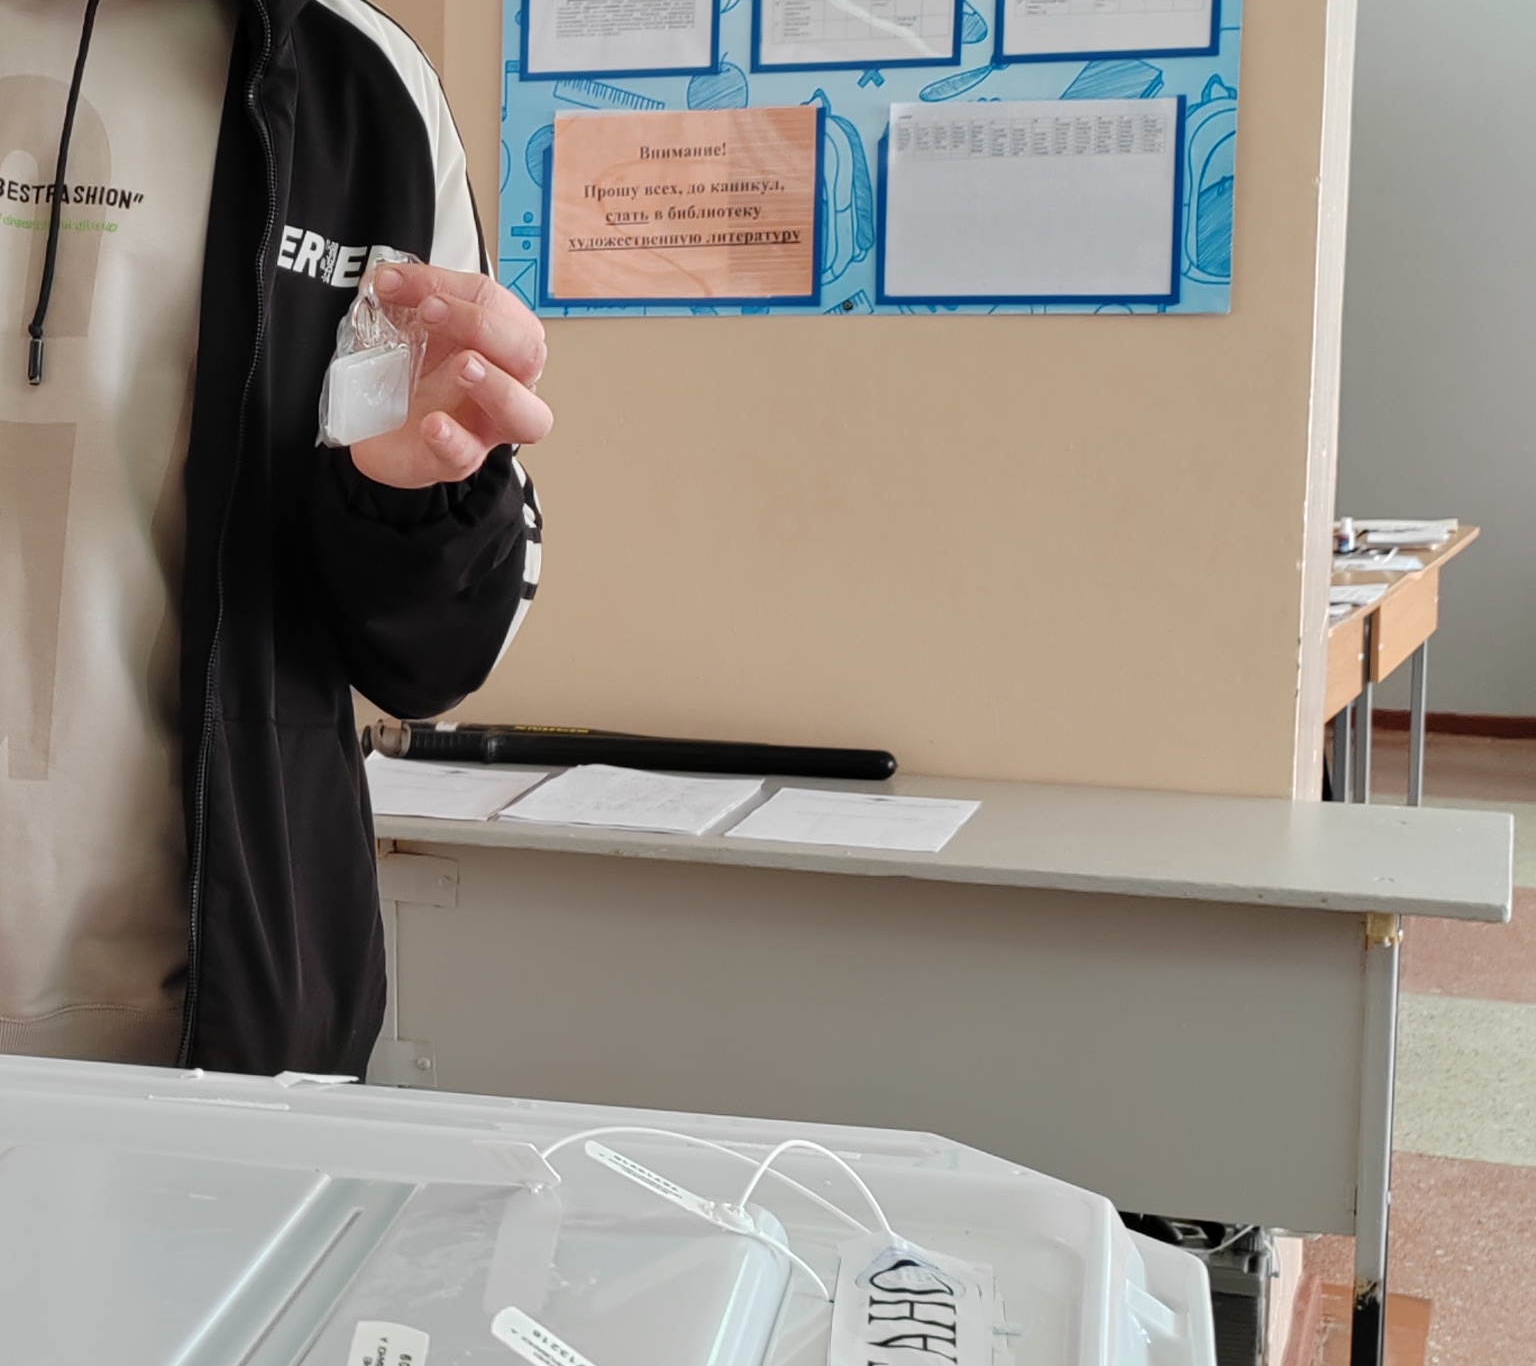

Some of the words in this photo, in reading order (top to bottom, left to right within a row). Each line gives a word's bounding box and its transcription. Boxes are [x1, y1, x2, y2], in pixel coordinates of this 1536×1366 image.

[639, 142, 727, 160] Внимание!
[584, 185, 639, 201] Прошу
[644, 184, 683, 197] всех,
[686, 183, 706, 197] до
[710, 179, 786, 196] каникул,
[654, 211, 663, 220] в
[667, 205, 763, 221] библиотеку
[568, 233, 703, 251] художественную
[706, 230, 801, 246] литературу
